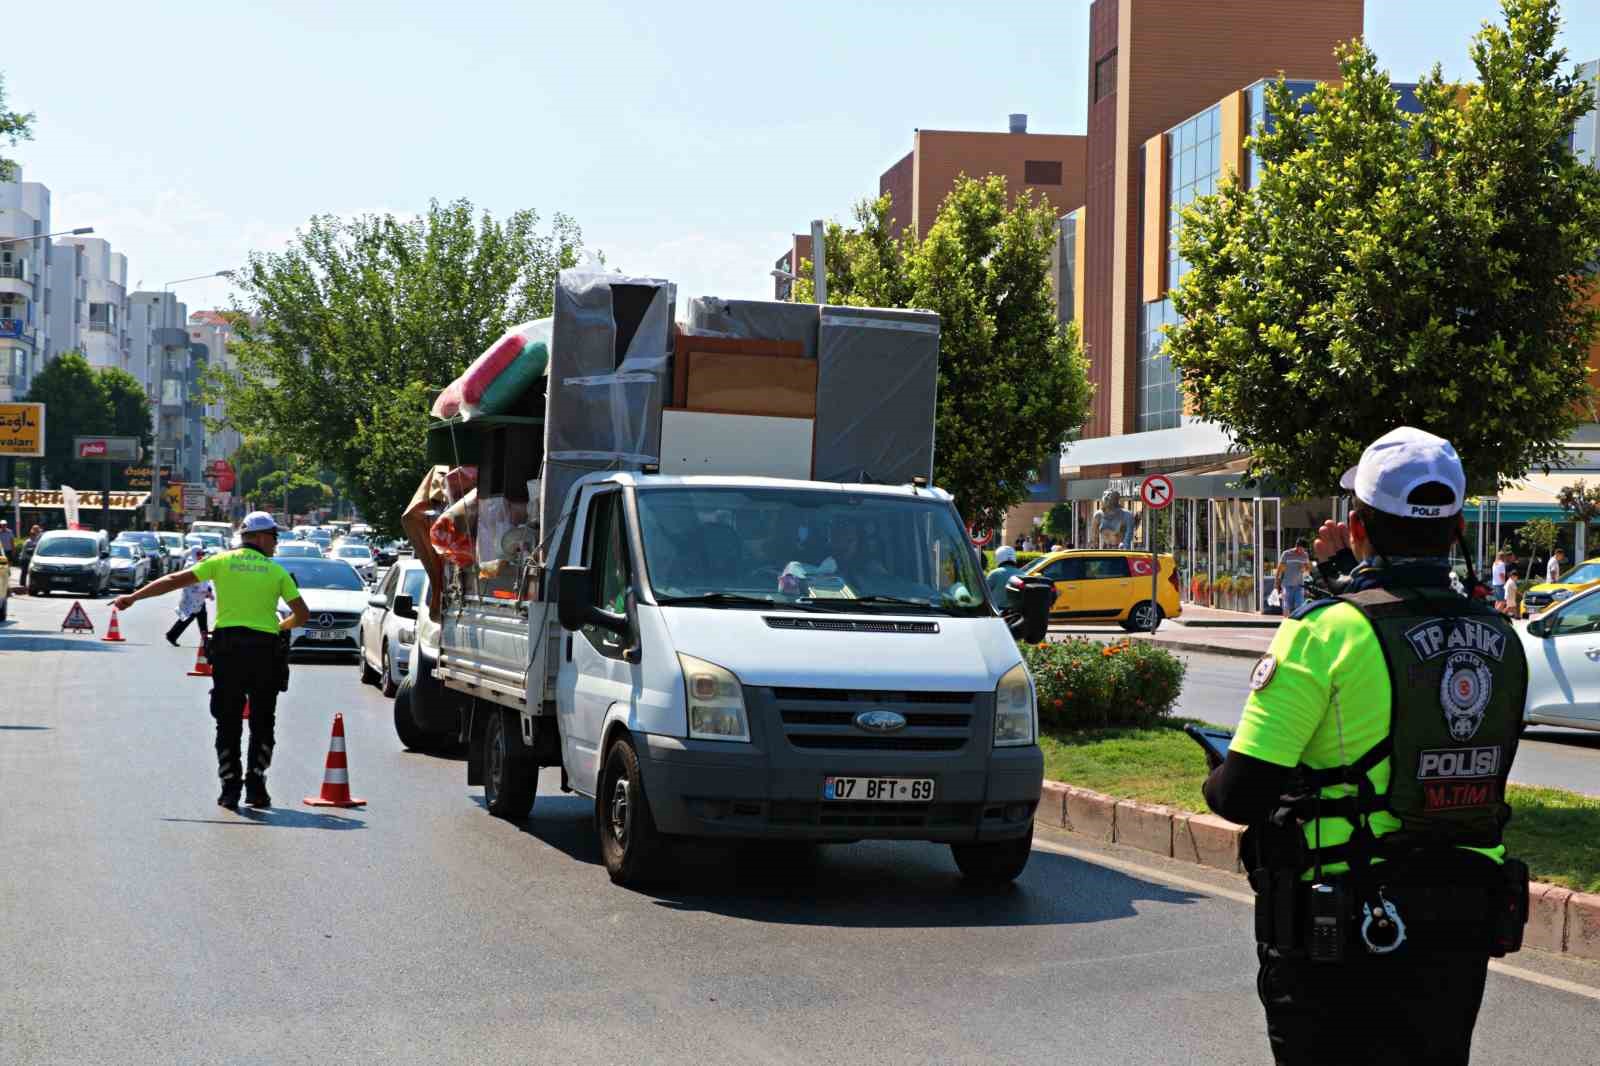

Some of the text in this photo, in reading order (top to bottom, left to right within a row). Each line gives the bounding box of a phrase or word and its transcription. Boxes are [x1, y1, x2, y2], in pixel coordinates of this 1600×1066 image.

[834, 779, 932, 799] 07 BFT 69
